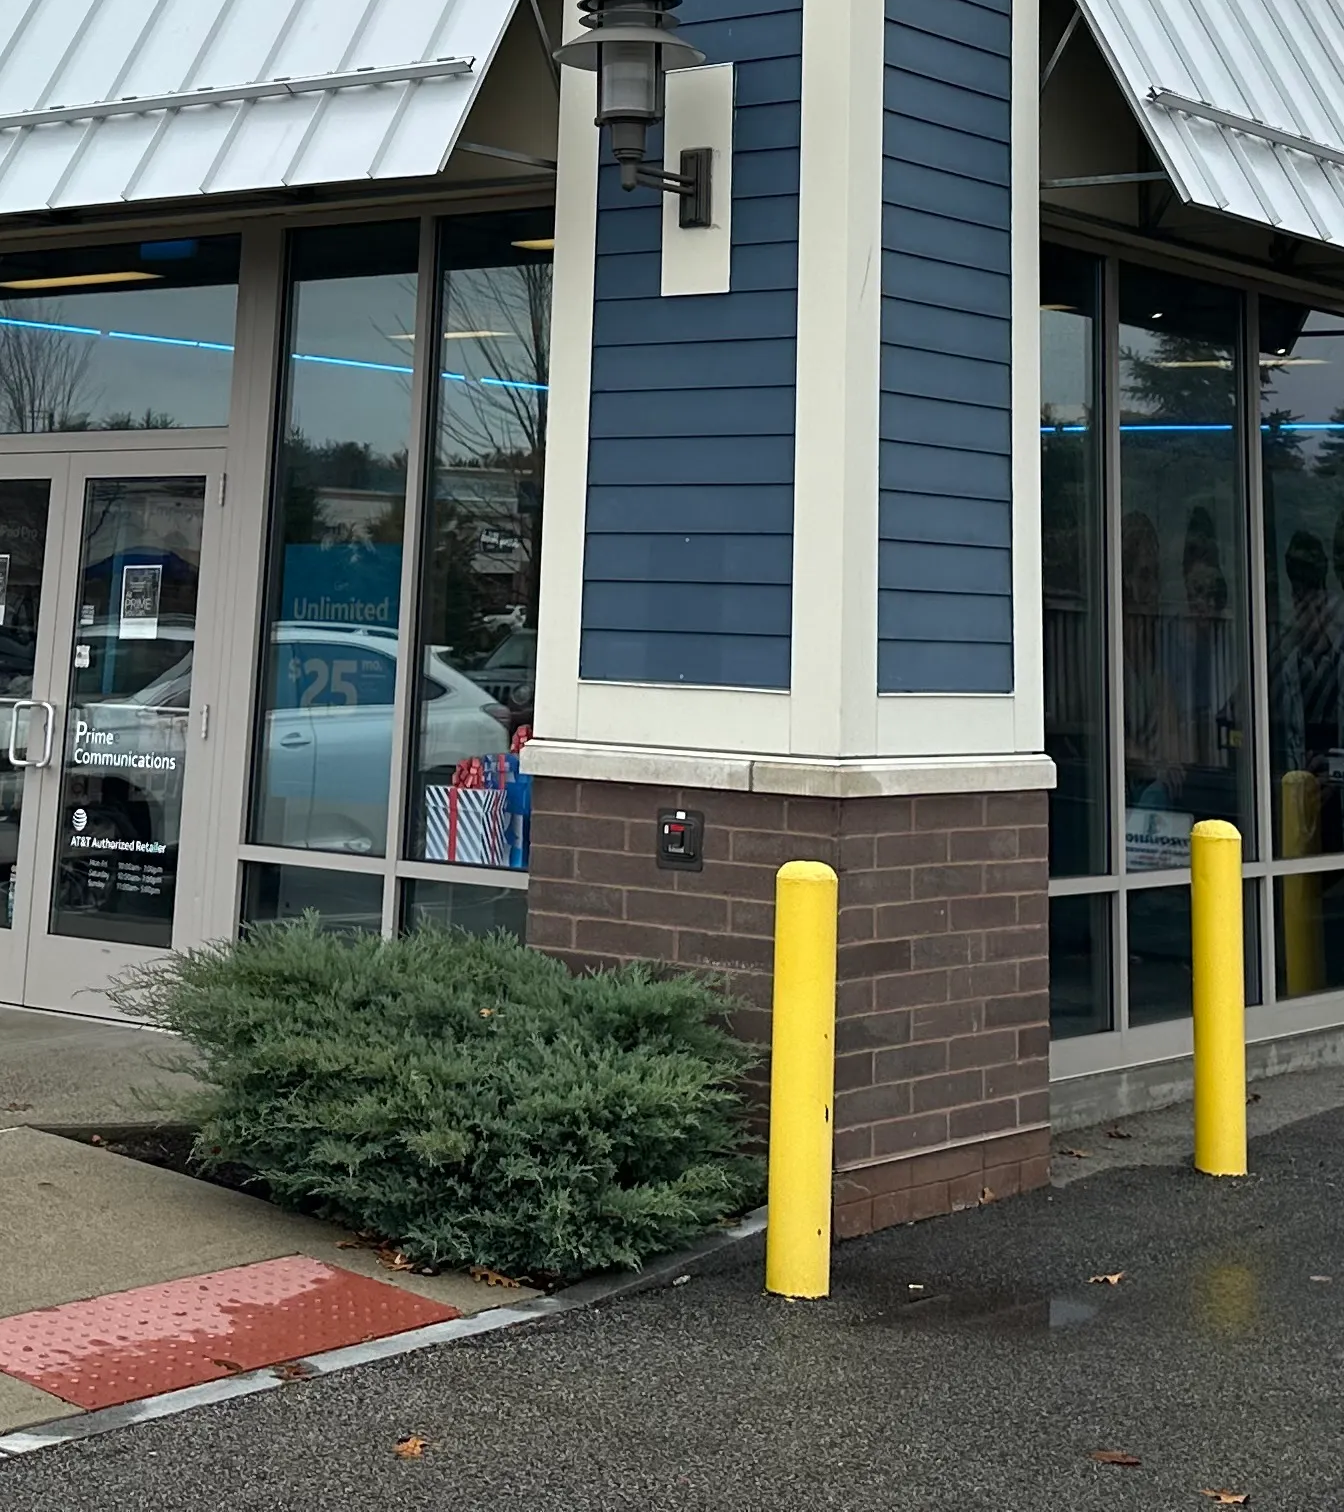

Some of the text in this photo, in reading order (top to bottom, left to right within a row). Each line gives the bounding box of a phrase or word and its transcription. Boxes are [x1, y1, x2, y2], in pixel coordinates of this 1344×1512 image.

[293, 596, 389, 622] Unlimited
[75, 720, 114, 745] Prime
[74, 747, 176, 770] Communications
[70, 835, 167, 854] AT&T Authorized Retailer
